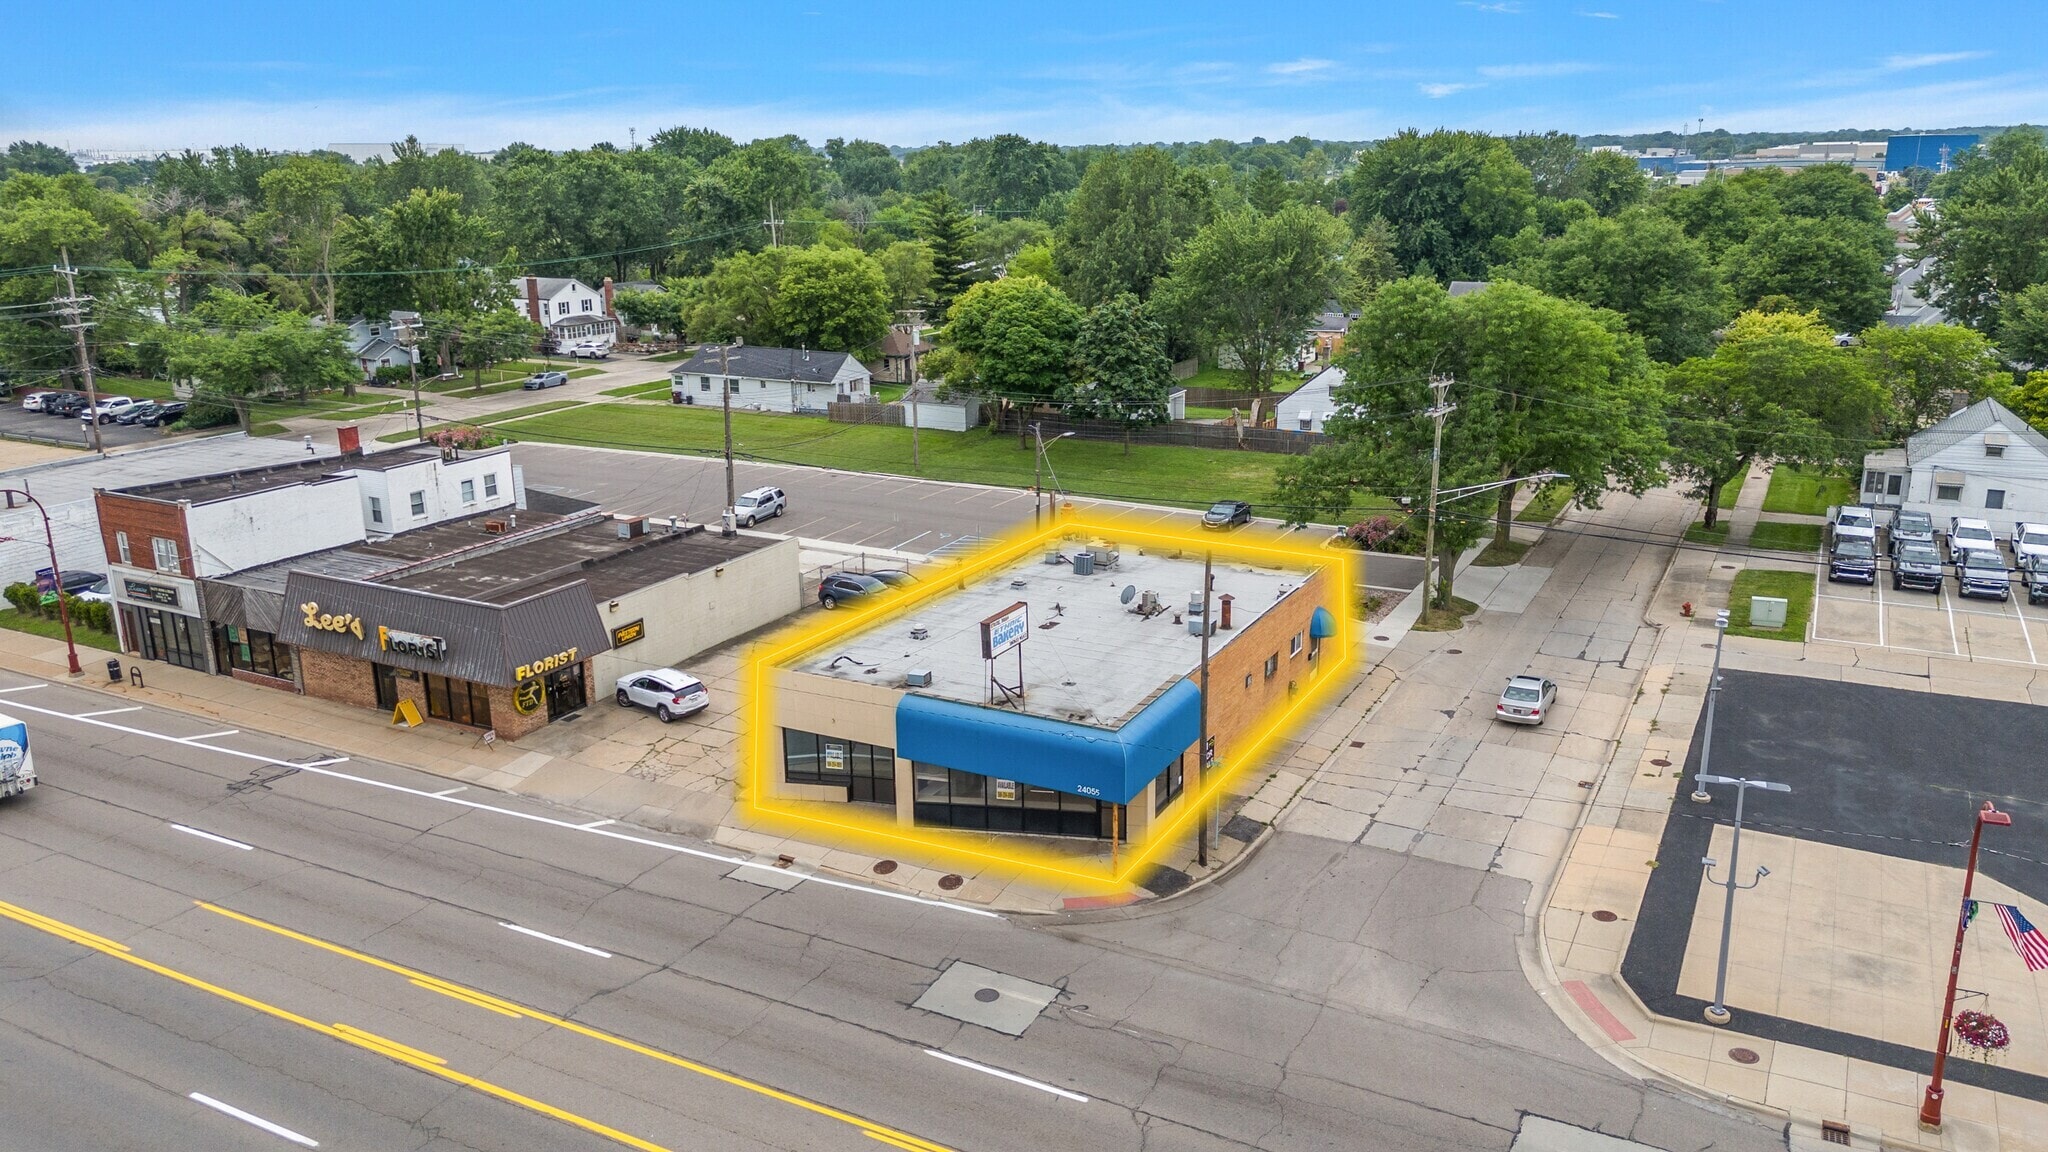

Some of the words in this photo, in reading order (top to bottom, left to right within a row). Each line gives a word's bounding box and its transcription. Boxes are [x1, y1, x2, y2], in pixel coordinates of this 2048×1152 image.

[300, 601, 366, 641] Lee's
[515, 647, 578, 682] FLORIST
[1077, 784, 1101, 797] 24055
